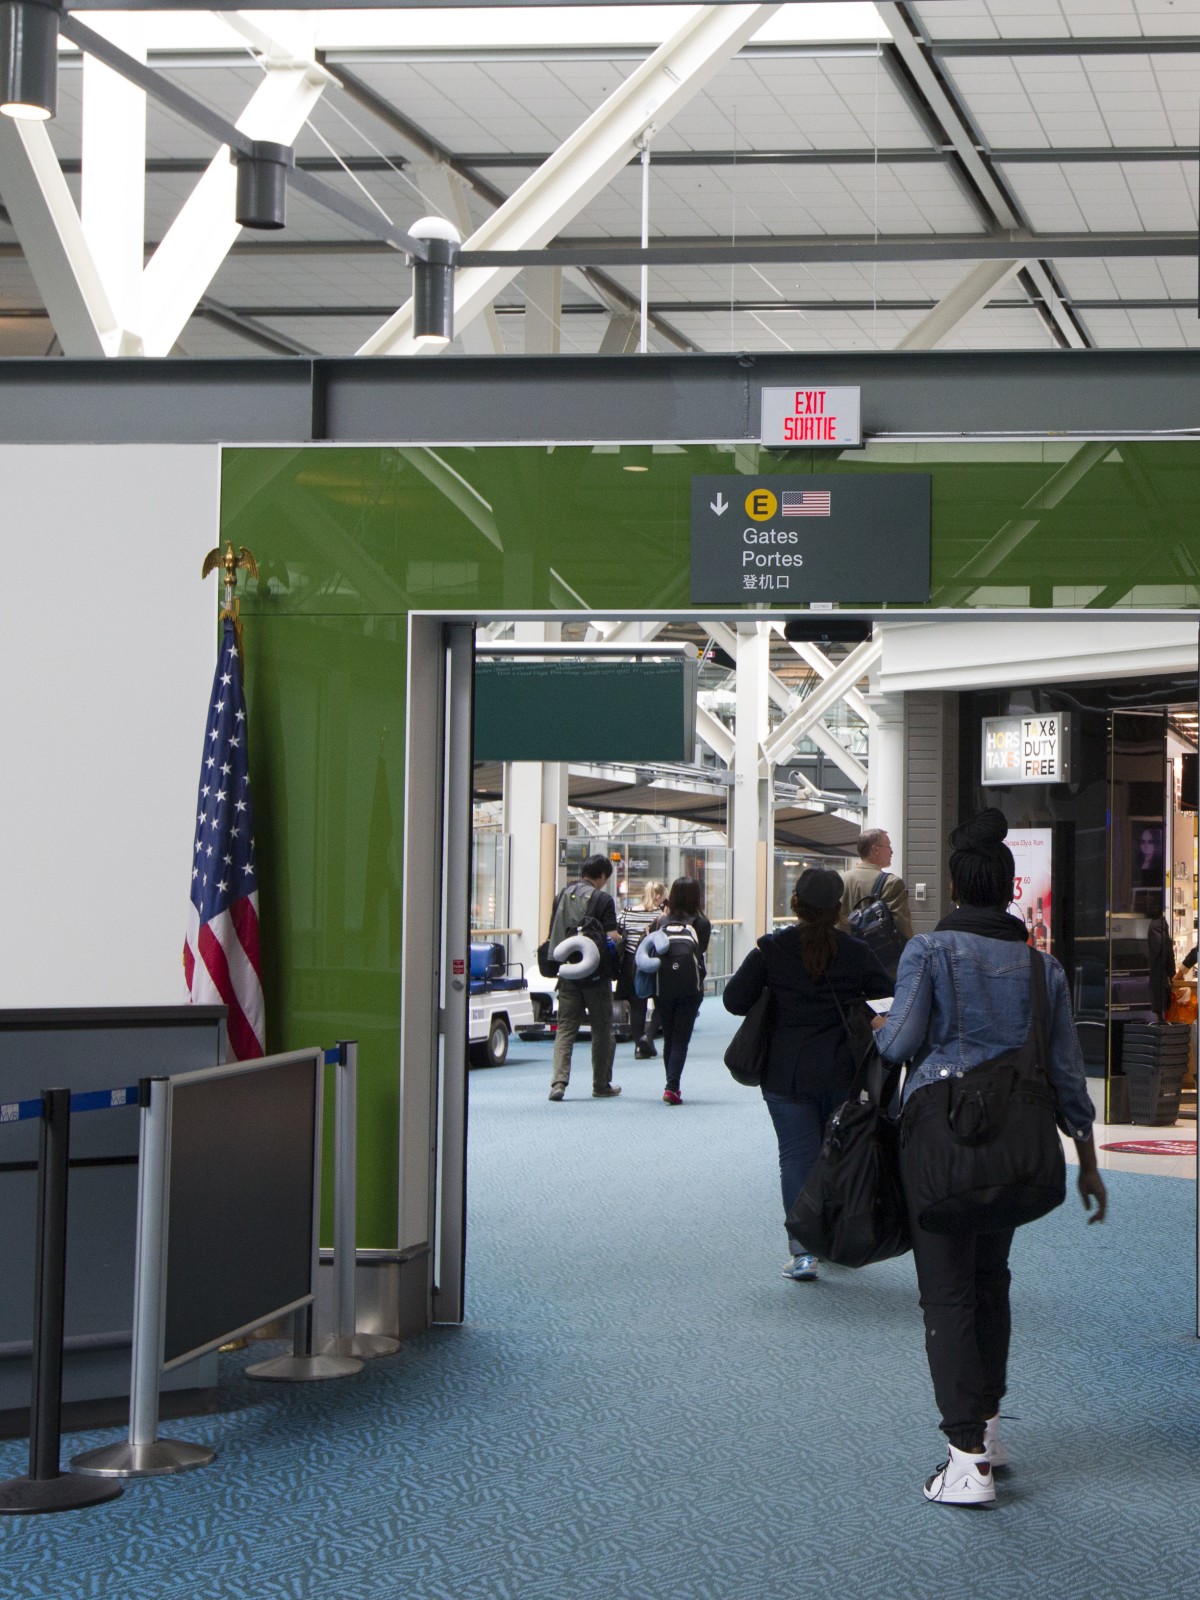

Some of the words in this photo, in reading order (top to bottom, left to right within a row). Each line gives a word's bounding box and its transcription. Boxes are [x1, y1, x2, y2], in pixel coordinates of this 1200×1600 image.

[795, 391, 826, 414] EXIT
[784, 417, 836, 441] SORTIE
[753, 495, 768, 515] E
[743, 528, 798, 544] Gates
[742, 551, 803, 567] Portes
[742, 574, 790, 590] 登机口
[986, 732, 1020, 749] HORS
[1025, 740, 1056, 757] DUTY
[986, 752, 1020, 769] TAXES
[1025, 760, 1055, 776] FREE
